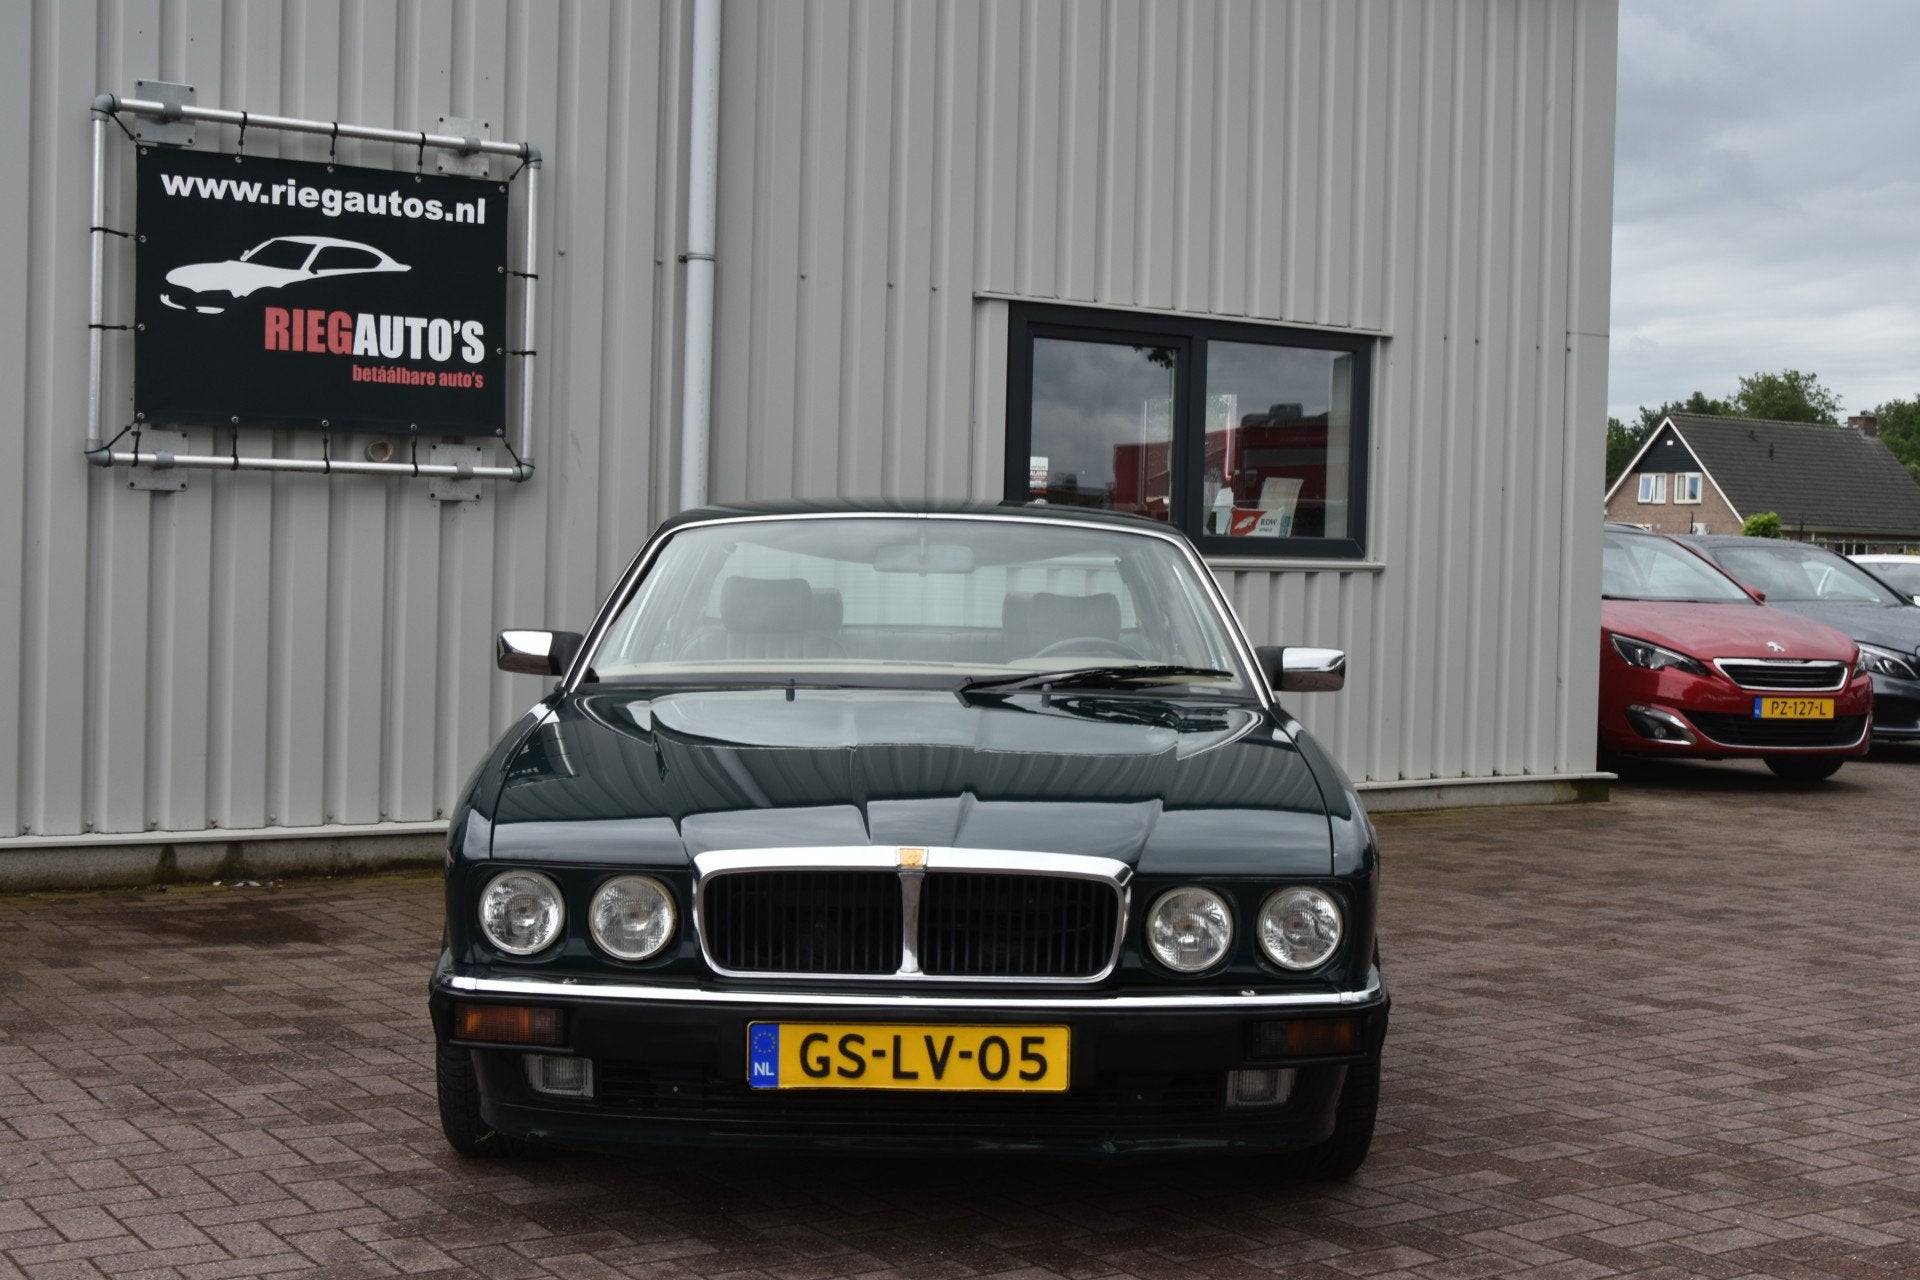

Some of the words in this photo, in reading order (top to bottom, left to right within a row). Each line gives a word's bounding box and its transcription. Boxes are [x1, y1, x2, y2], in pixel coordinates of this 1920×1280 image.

[161, 173, 486, 225] www.riegautos.nl
[264, 306, 485, 364] RIEGAUTO'S
[352, 364, 436, 386] betáálbare
[438, 371, 484, 389] auto's
[1260, 518, 1278, 526] RDW
[1770, 700, 1827, 716] PZ-127-L
[799, 1032, 1049, 1081] GS-LV-05
[753, 1062, 775, 1077] NL
